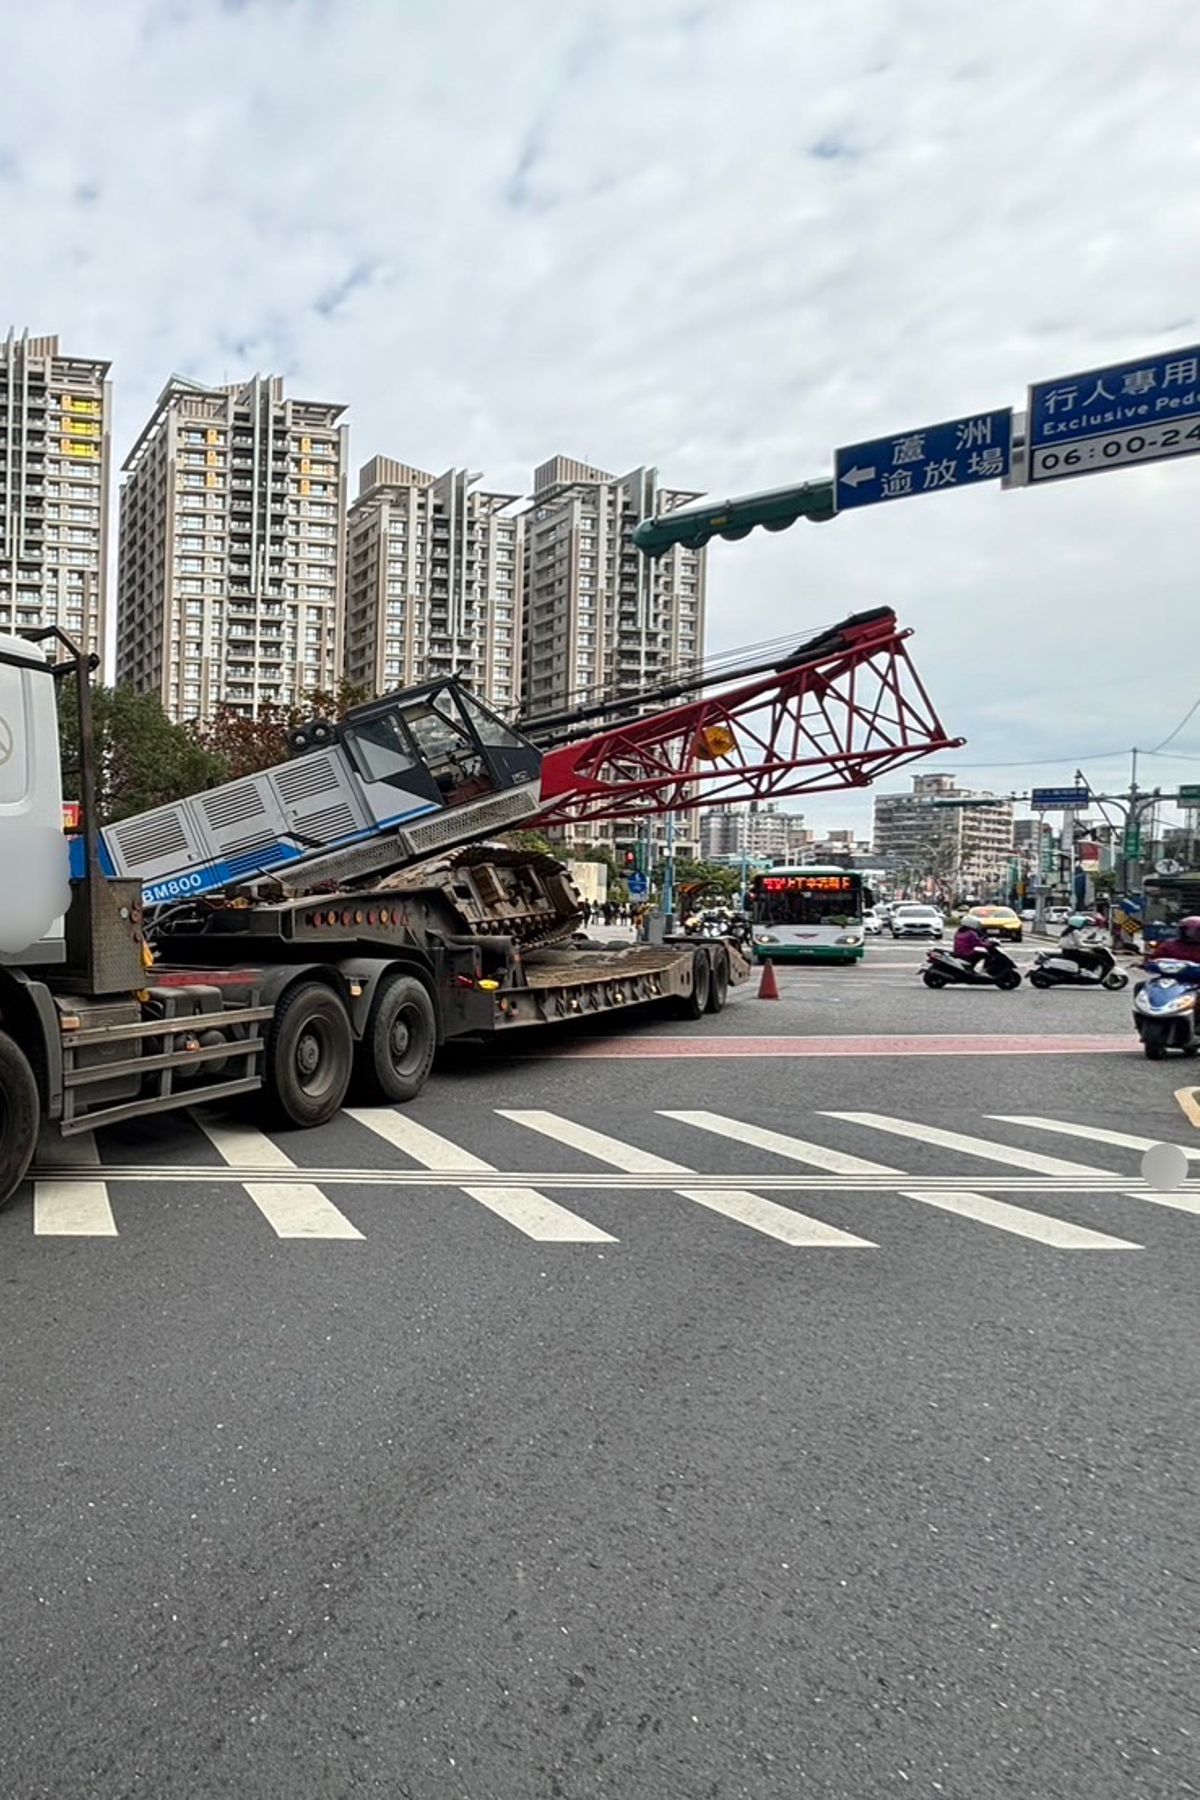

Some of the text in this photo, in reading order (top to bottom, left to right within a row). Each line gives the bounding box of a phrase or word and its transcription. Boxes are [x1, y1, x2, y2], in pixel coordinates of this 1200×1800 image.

[1044, 358, 1198, 415] 行人專用
[1043, 391, 1200, 436] Exclusive Ped
